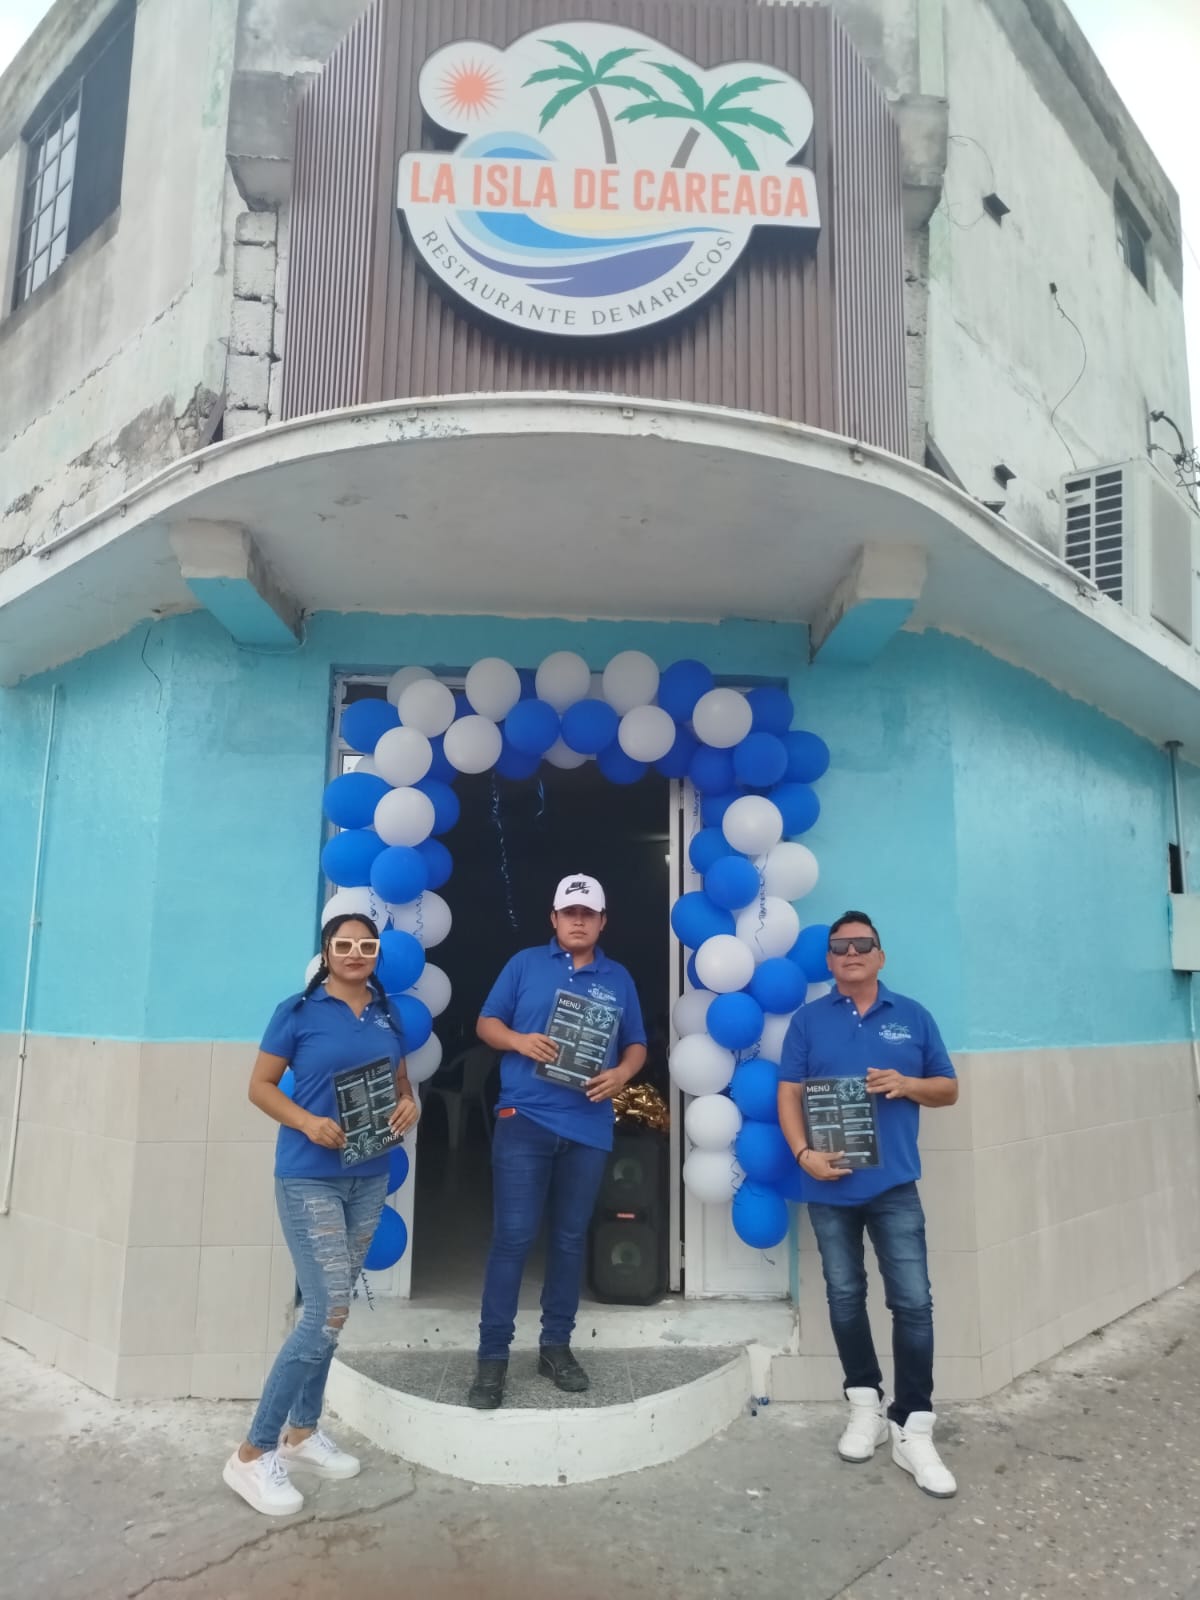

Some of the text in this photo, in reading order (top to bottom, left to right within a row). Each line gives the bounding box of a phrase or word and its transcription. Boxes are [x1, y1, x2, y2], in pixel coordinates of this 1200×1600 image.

[410, 161, 809, 218] LA ISLA DE CAREAGA
[421, 230, 733, 326] RESTAURANTE DE MARISCOS
